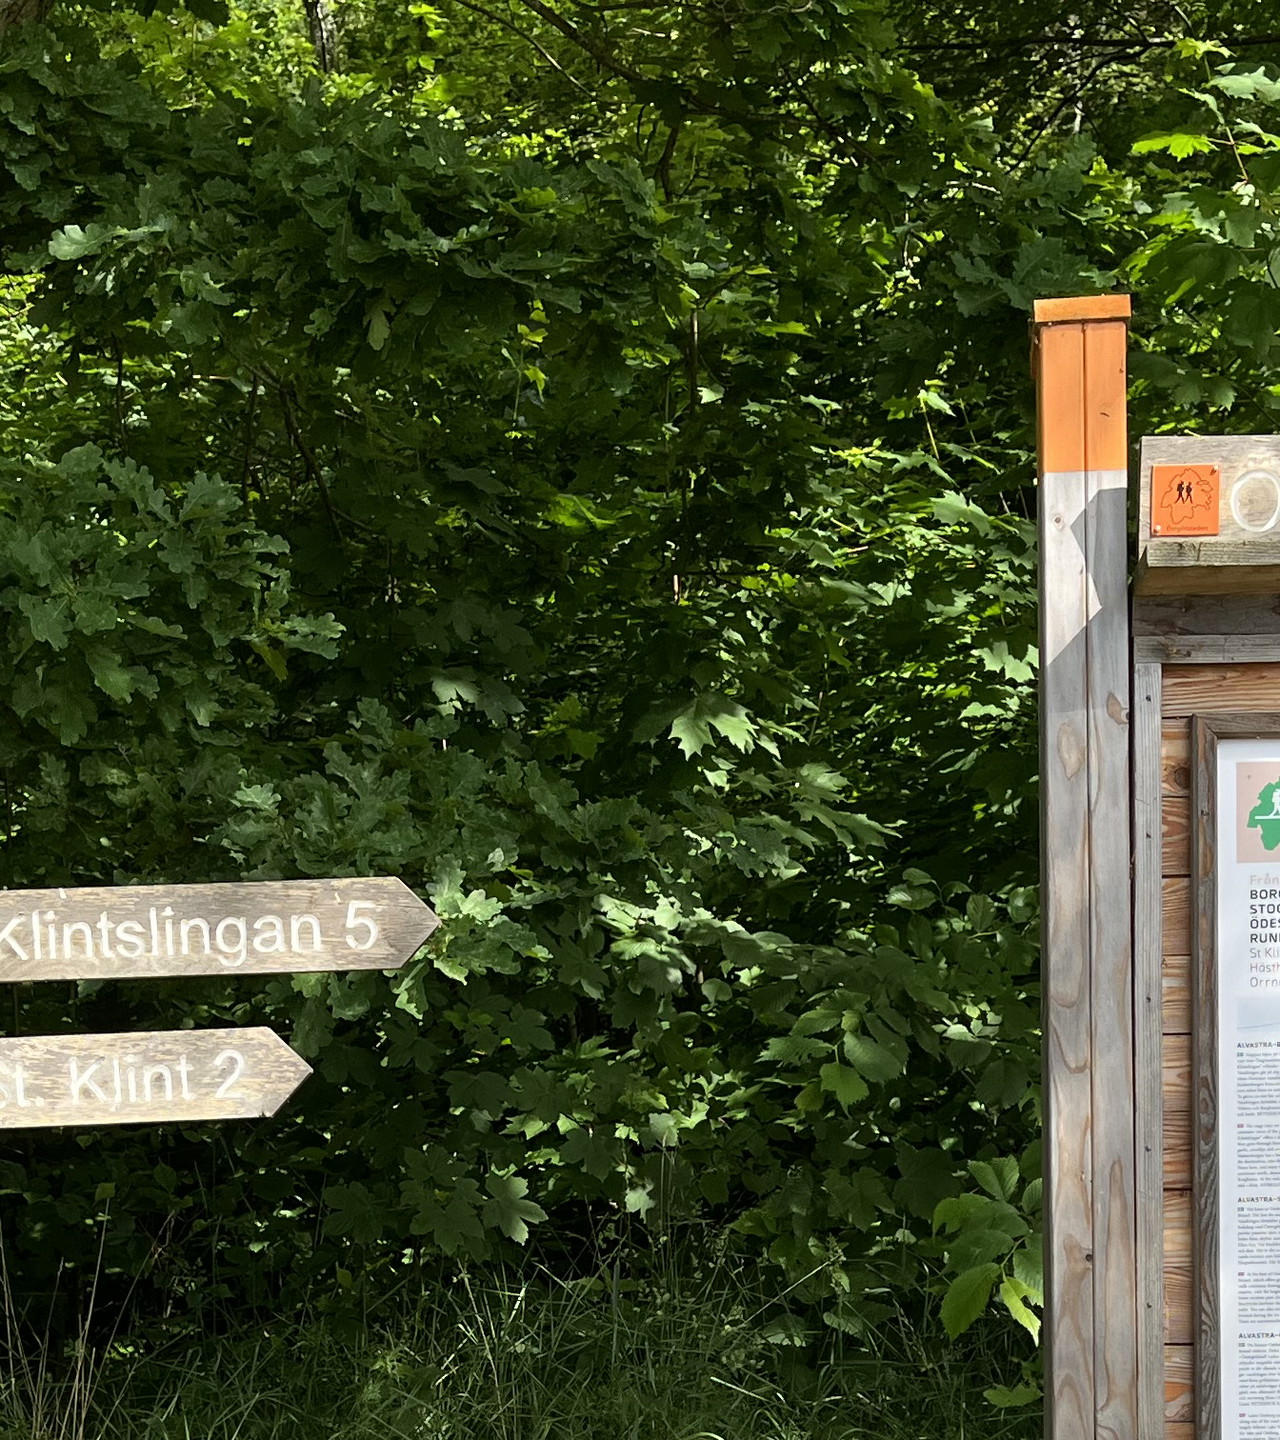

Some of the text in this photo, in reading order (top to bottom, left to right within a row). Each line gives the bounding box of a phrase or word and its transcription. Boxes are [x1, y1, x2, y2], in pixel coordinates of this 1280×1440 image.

[1249, 873, 1280, 886] Från
[343, 900, 380, 951] 5
[1249, 947, 1261, 959] St
[68, 1053, 193, 1108] Klint
[214, 1048, 247, 1101] 2
